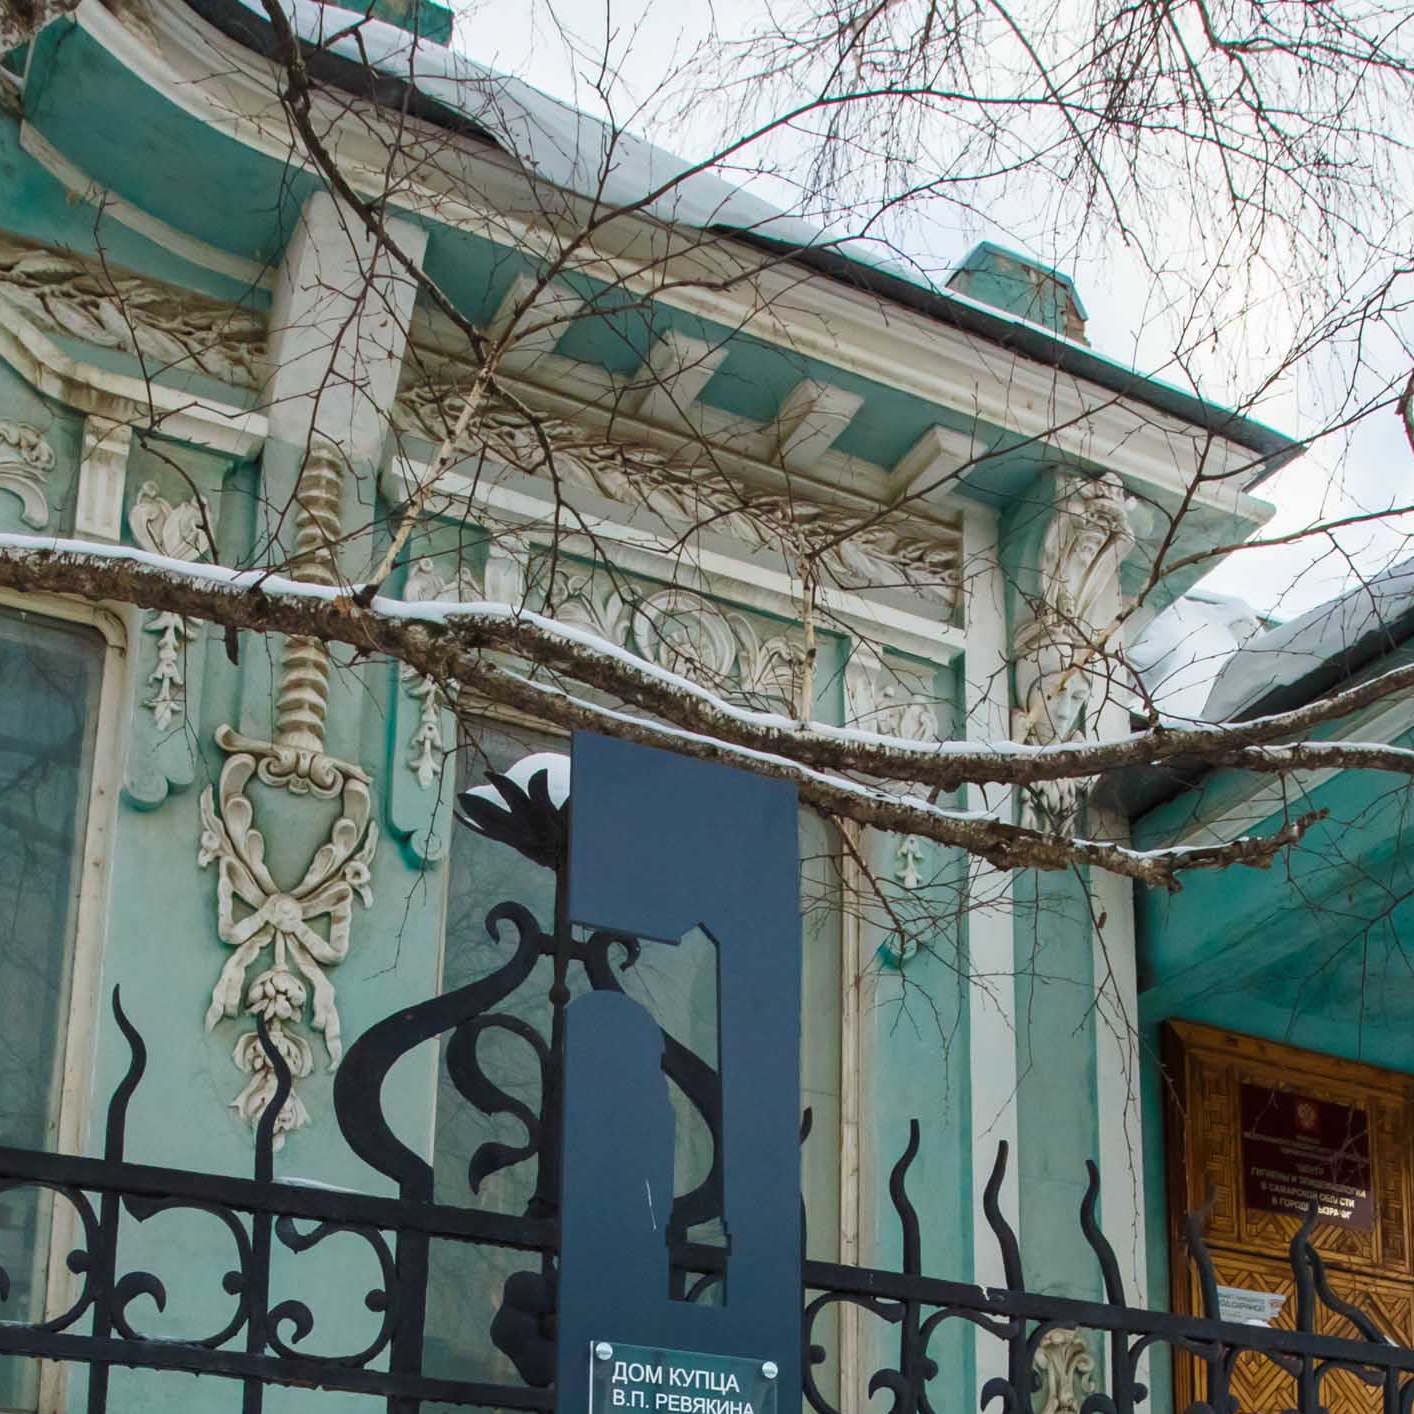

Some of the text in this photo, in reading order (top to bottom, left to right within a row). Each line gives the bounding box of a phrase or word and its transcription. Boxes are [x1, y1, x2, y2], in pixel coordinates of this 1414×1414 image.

[612, 1361, 740, 1396] ДОМ КУПЦА
[612, 1388, 649, 1409] В.П.
